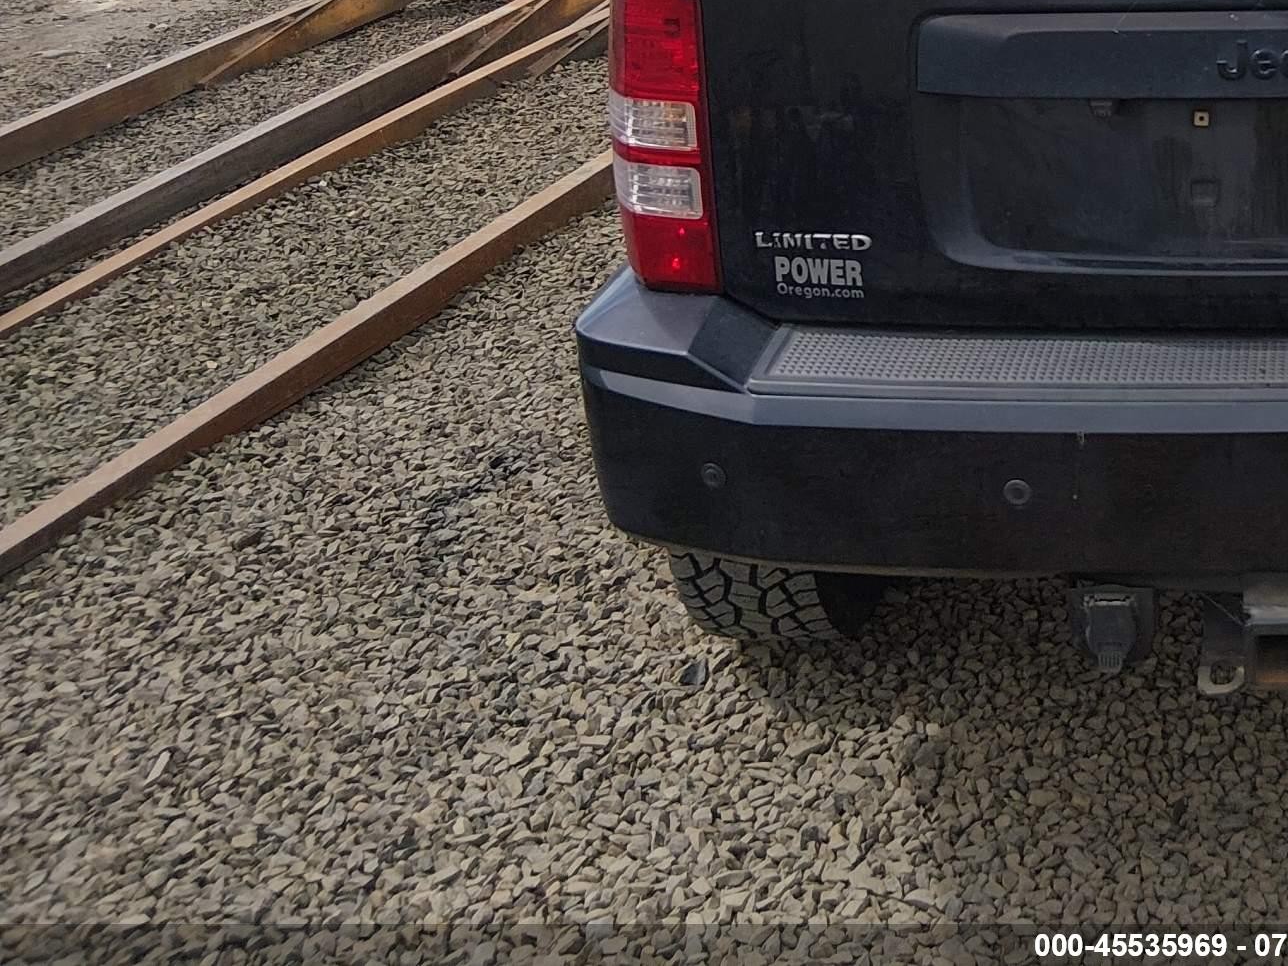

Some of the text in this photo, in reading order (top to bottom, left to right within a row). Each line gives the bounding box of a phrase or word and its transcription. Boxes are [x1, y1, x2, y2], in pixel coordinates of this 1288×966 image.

[755, 232, 872, 250] LIMITED
[774, 256, 863, 286] POWER
[777, 282, 864, 298] Oregon.com
